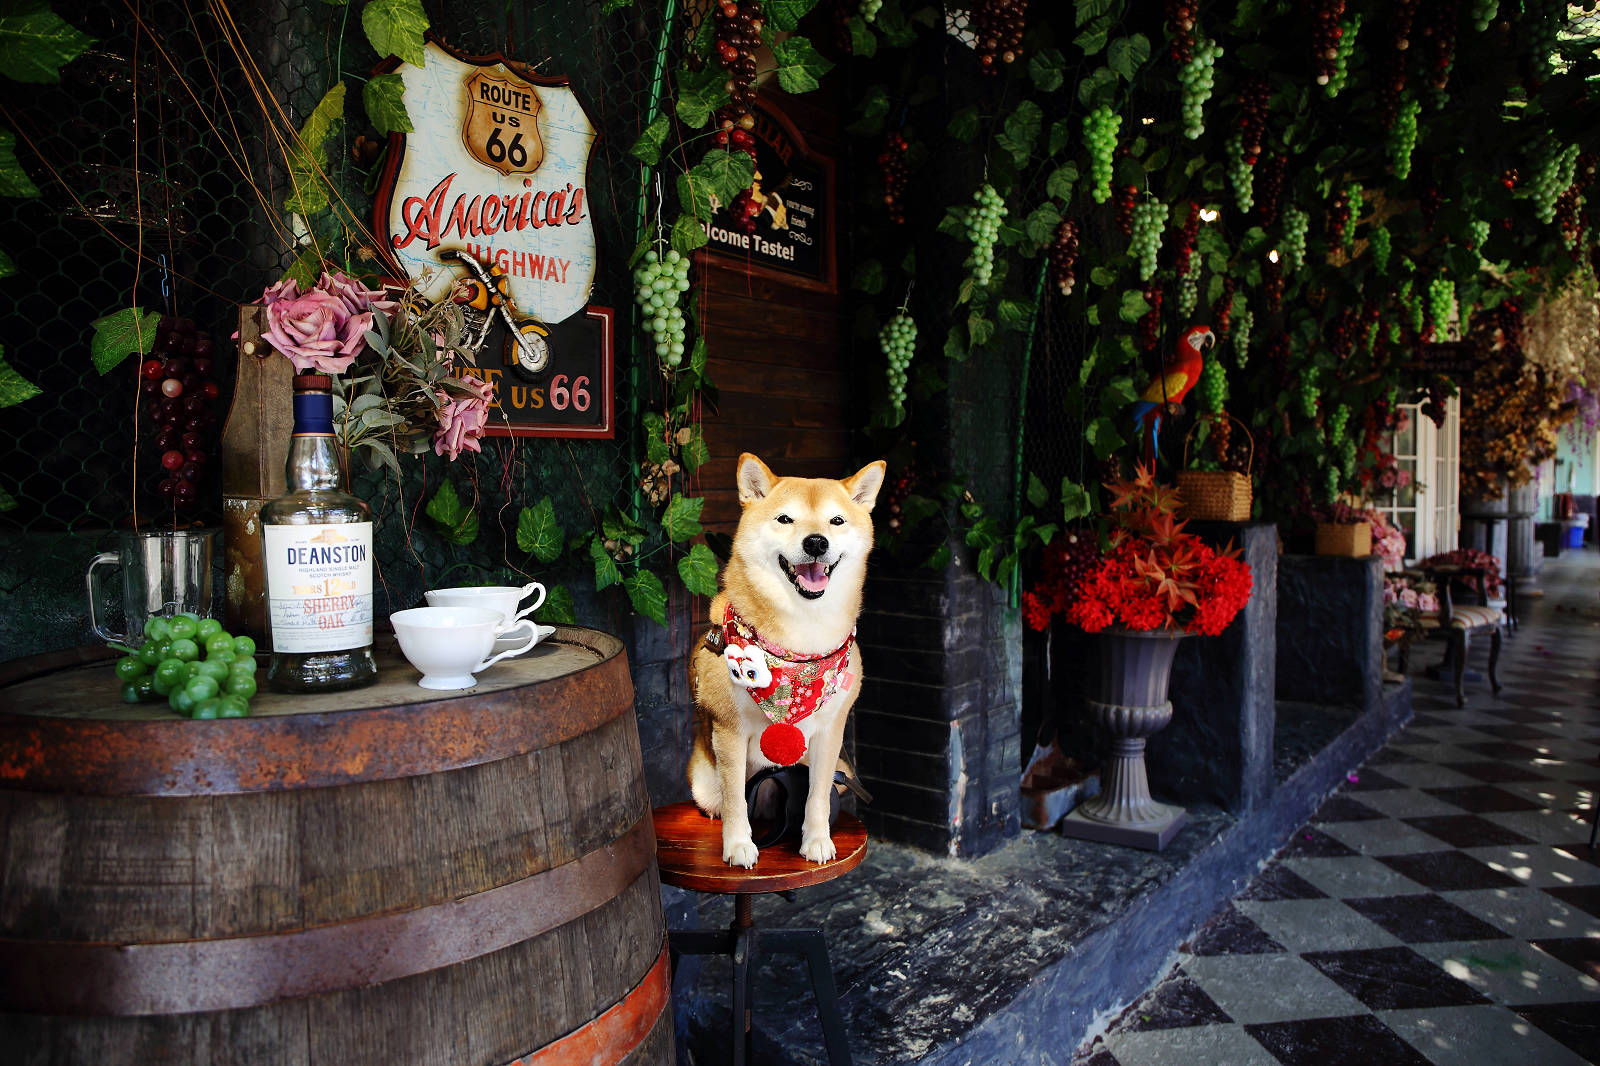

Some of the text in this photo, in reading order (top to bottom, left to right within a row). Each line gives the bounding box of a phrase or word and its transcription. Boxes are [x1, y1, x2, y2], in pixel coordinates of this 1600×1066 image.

[480, 82, 531, 111] ROUTE
[492, 112, 521, 128] US
[486, 128, 528, 168] 66
[392, 172, 587, 250] America's
[700, 222, 795, 261] lcome Taste!
[511, 385, 545, 409] US
[549, 374, 591, 412] 66
[287, 544, 366, 565] DEANSTON
[292, 584, 322, 595] YEARS
[323, 578, 341, 596] 12
[303, 594, 356, 614] SHERRY
[318, 612, 345, 630] OAK
